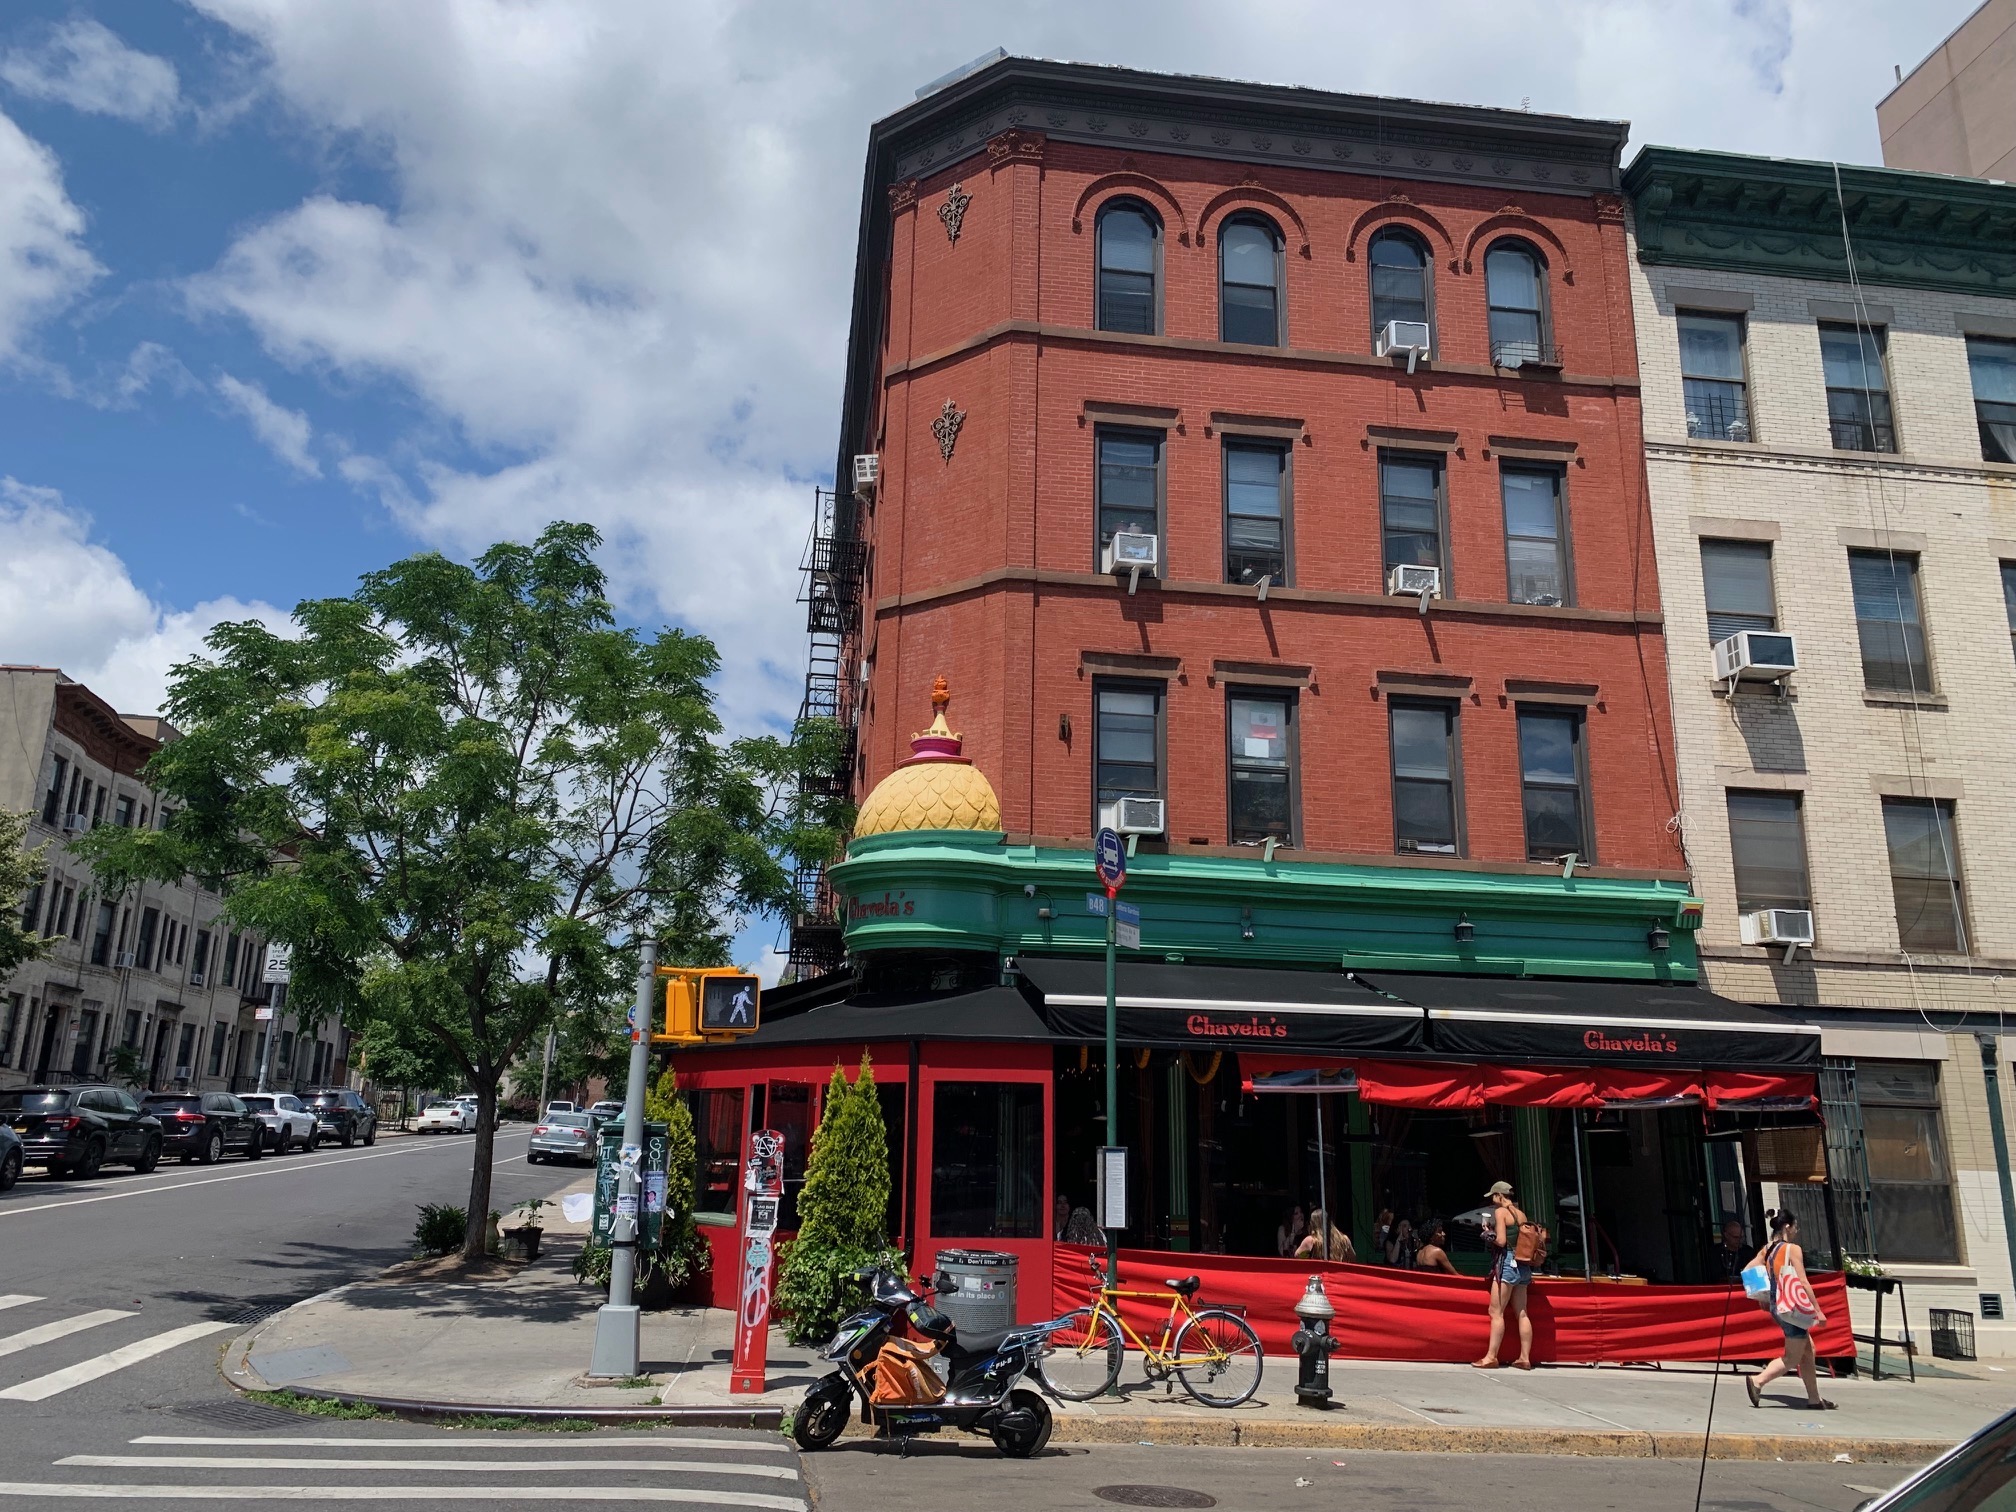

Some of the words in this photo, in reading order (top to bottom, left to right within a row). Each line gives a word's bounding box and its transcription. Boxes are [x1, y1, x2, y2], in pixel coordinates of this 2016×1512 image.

[1089, 898, 1104, 912] B48
[268, 959, 288, 971] 25
[1186, 1014, 1288, 1038] Chavela's
[1583, 1030, 1678, 1053] Chavela's
[966, 1291, 976, 1299] its
